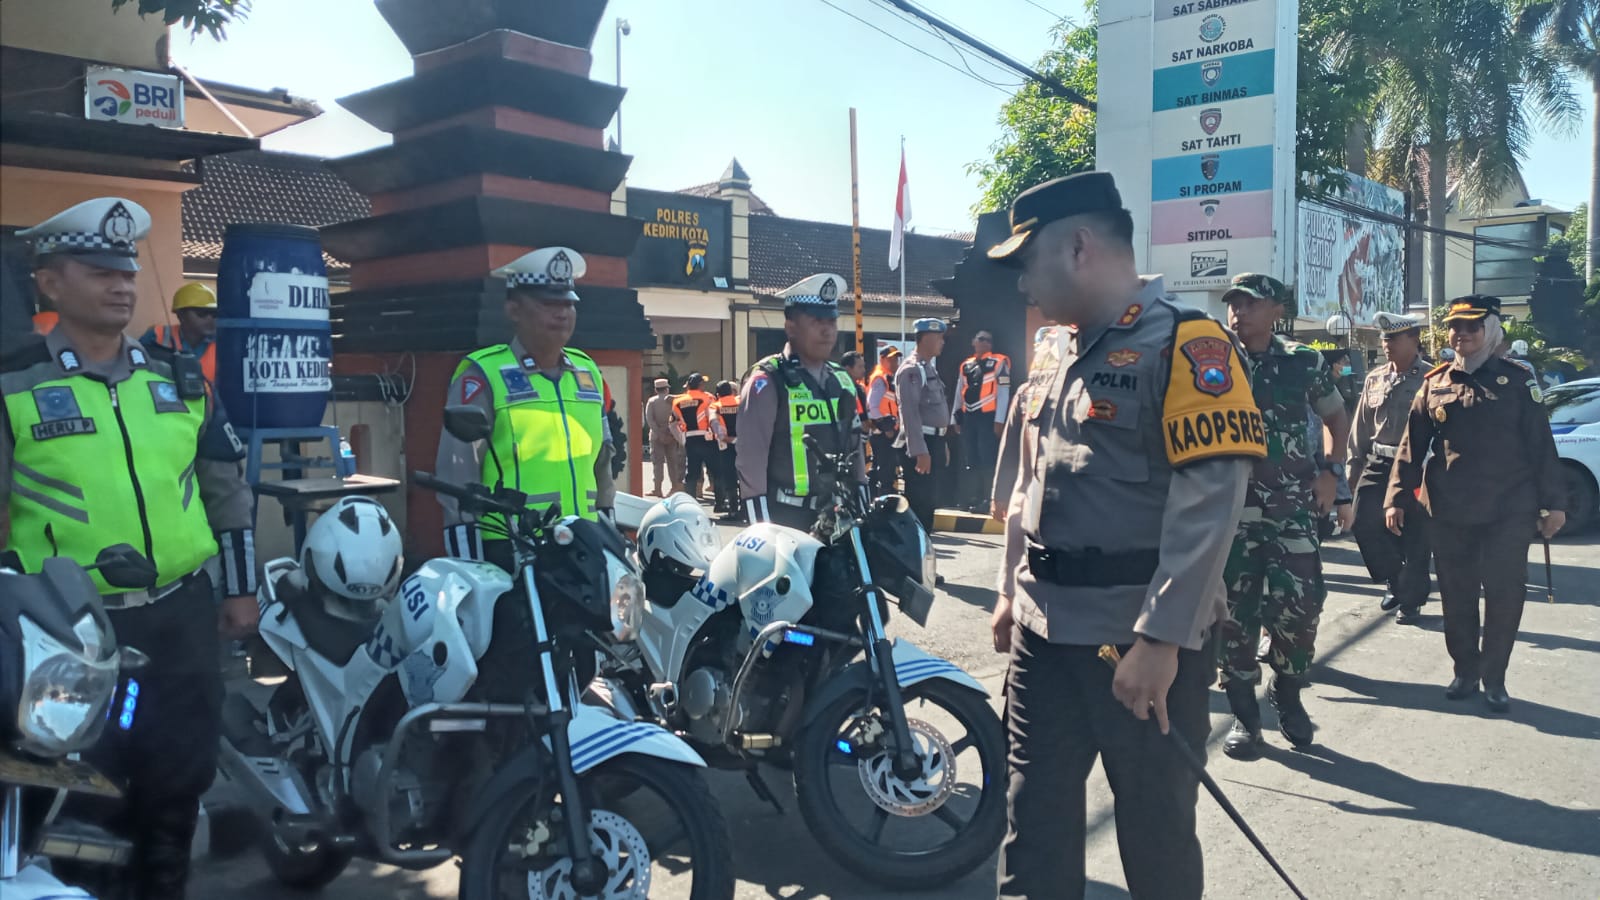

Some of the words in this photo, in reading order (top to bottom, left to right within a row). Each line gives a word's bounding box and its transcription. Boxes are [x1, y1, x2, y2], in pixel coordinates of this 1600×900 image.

[1173, 2, 1195, 16] SAT
[1172, 49, 1194, 62] SAT
[1197, 38, 1254, 58] NARKOBA
[134, 82, 175, 109] BRI
[1177, 94, 1199, 107] SAT
[1201, 86, 1248, 104] BINMAS
[135, 107, 177, 121] peduli
[1181, 138, 1203, 152] SAT
[1207, 133, 1241, 148] TAHTI
[1180, 185, 1191, 197] SI
[1194, 180, 1242, 195] PROPAM
[656, 207, 700, 226] POLRES
[643, 222, 680, 239] KEDIRI
[681, 226, 709, 243] KOTA
[1187, 228, 1233, 242] SITIPOL
[248, 360, 291, 380] KOTA
[1092, 371, 1137, 391] POLRI
[36, 420, 76, 438] HERU
[82, 418, 91, 433] P
[1167, 409, 1264, 455] KAOPSRES
